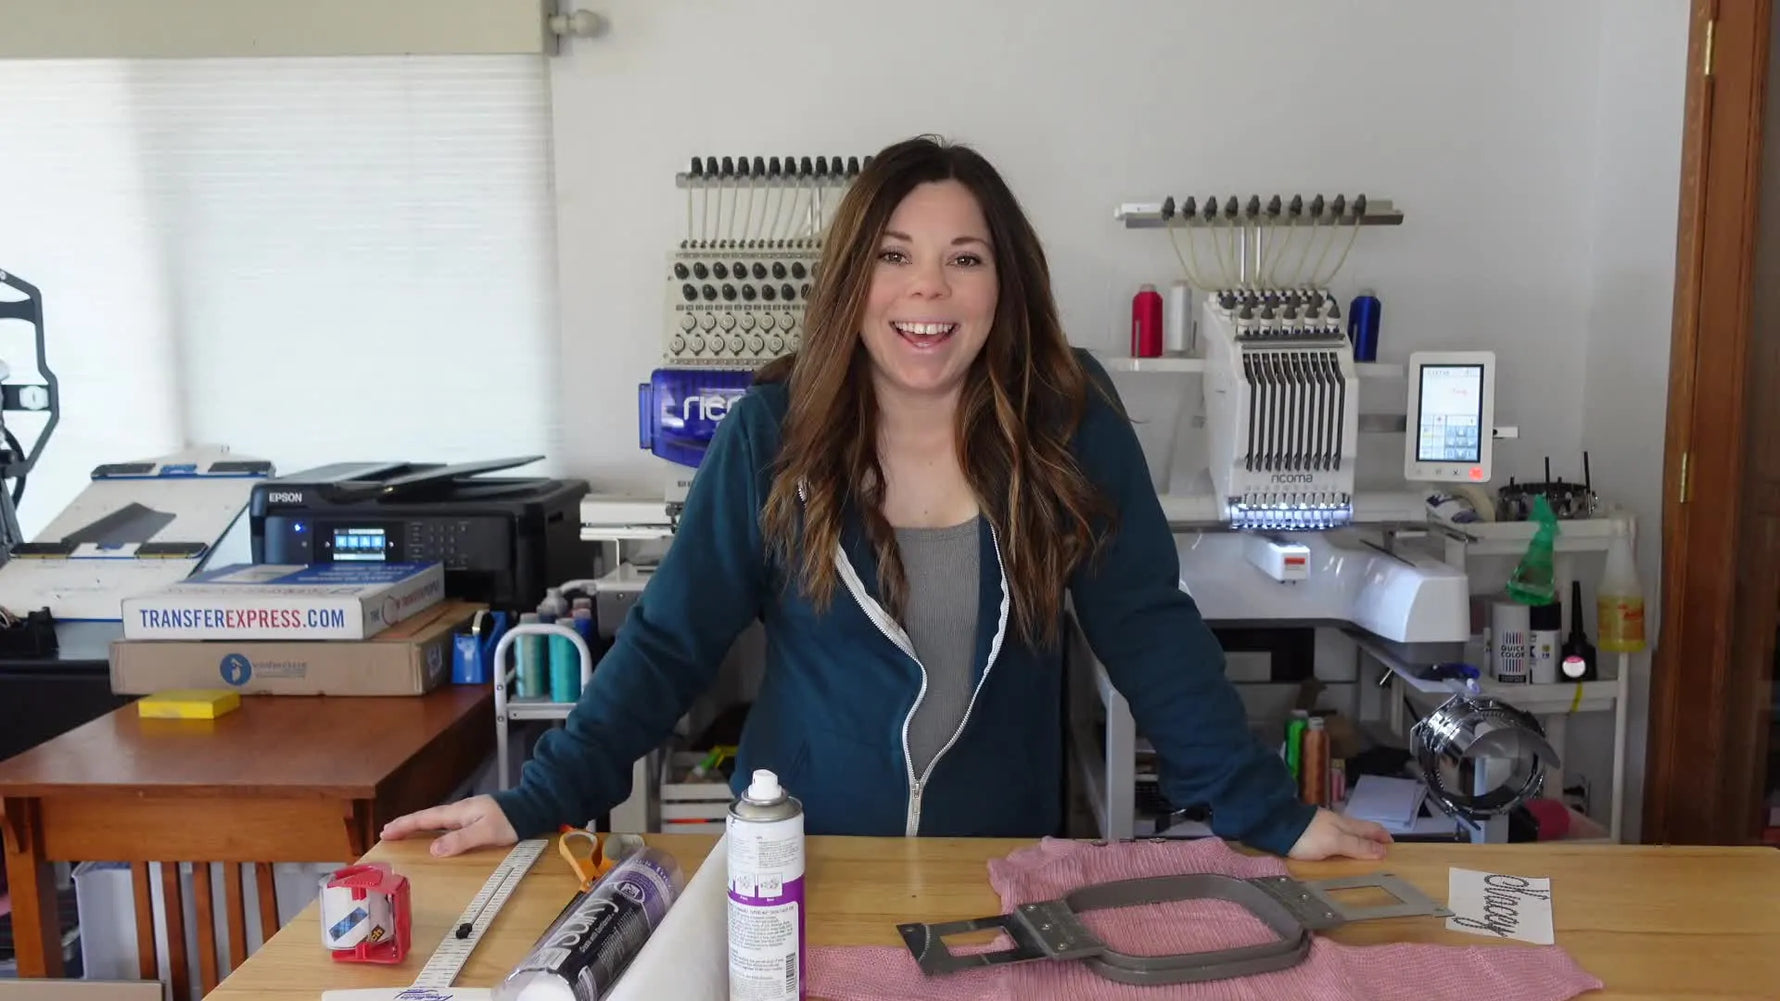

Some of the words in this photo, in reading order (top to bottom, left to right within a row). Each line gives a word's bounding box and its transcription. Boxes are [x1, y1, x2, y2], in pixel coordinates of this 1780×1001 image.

[1271, 474, 1313, 484] ricoma
[269, 493, 302, 503] EPSON
[140, 609, 345, 629] TRANSFEREXPRESS.COM
